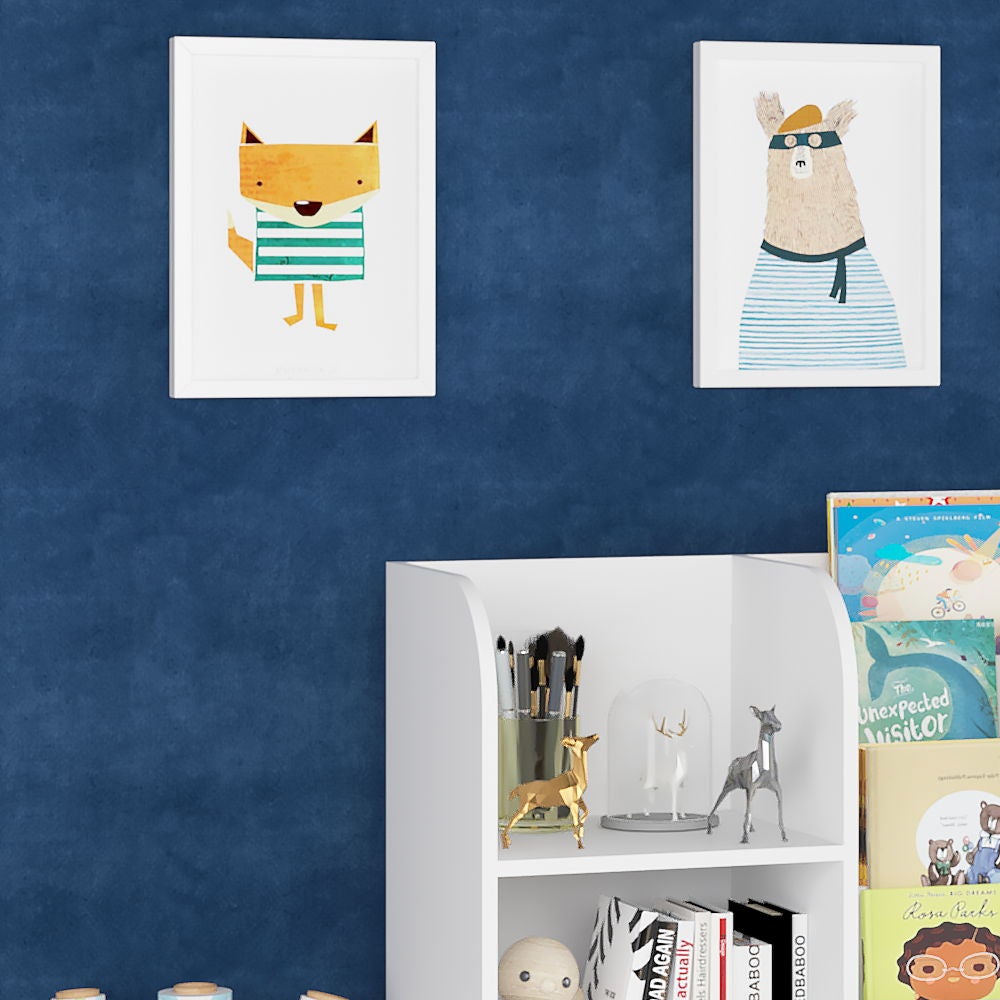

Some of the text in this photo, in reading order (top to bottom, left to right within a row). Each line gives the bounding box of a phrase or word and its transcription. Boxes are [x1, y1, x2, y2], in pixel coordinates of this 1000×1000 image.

[858, 687, 950, 725] Unexpected
[903, 898, 999, 921] Rosa Parks
[652, 928, 676, 977] AGAIN
[674, 939, 695, 998] actually
[697, 921, 708, 987] Hairdressers
